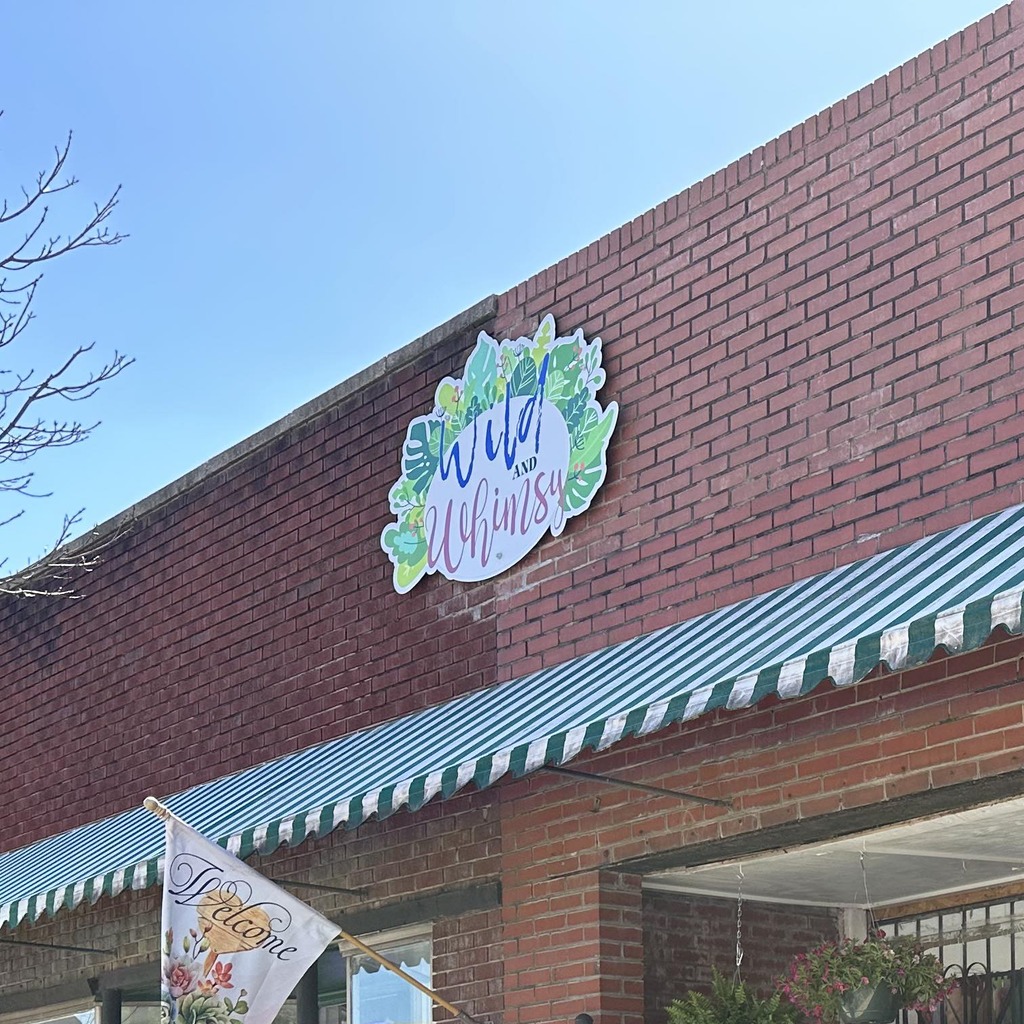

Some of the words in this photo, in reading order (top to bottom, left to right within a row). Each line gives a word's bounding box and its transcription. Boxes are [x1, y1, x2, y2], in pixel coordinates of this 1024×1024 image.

[440, 352, 549, 488] Wild
[512, 456, 538, 481] AND
[425, 468, 566, 574] Whimsy
[168, 852, 298, 961] Welcome
